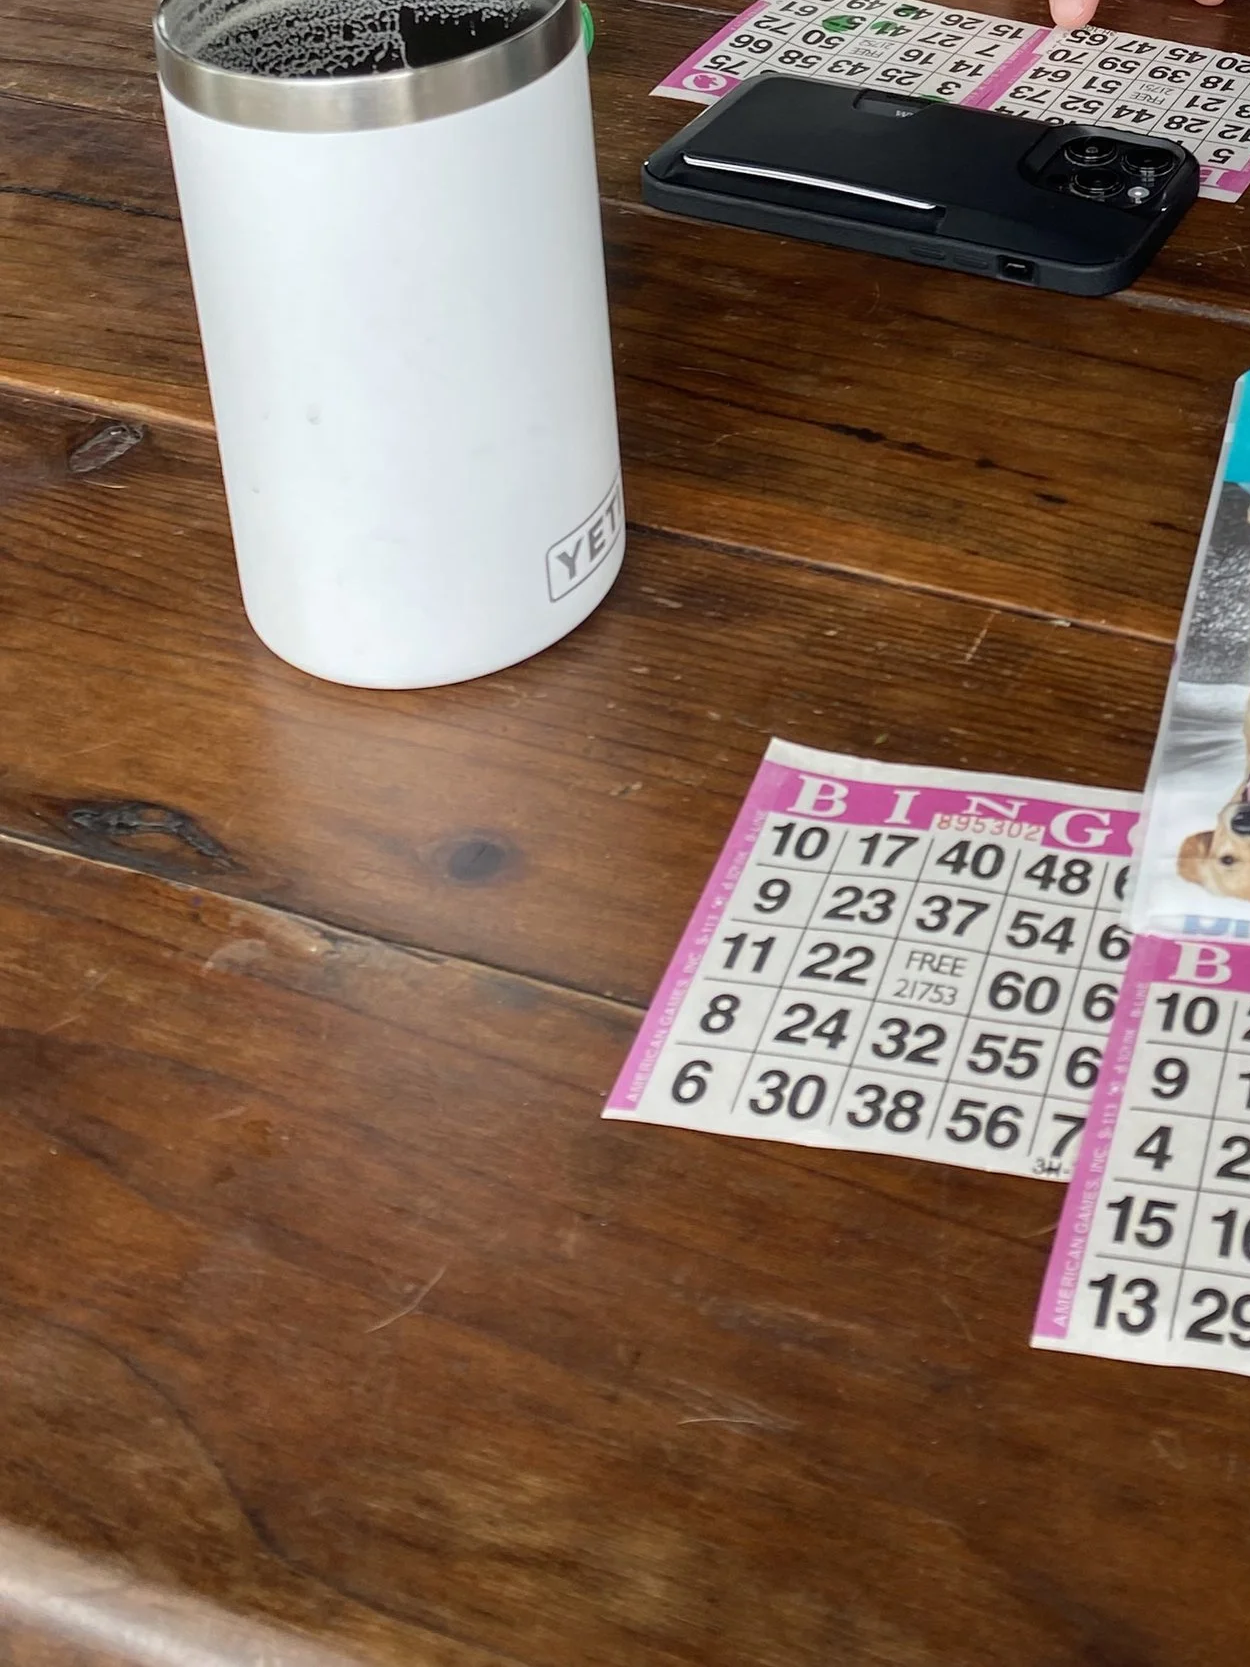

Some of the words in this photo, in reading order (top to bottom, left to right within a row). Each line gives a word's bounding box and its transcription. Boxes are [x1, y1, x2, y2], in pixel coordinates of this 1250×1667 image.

[893, 3, 934, 20] 42
[940, 14, 984, 30] 26
[988, 24, 1025, 39] 15
[1065, 29, 1109, 46] 65
[853, 48, 883, 59] FREE
[1113, 40, 1157, 54] 47
[1164, 47, 1208, 64] 45
[1131, 92, 1167, 105] FREE
[787, 773, 1142, 852] BING
[935, 812, 1042, 844] 895302
[773, 822, 829, 860] 10
[860, 833, 919, 867] 17
[937, 840, 1004, 879] 40
[1025, 854, 1093, 895] 48
[724, 933, 775, 972] 11
[799, 942, 874, 984] 22
[905, 951, 967, 978] FREE
[989, 970, 1060, 1014] 60
[893, 978, 959, 1006] 21753
[1157, 992, 1219, 1035] 10
[1135, 1126, 1172, 1170] 4
[1053, 1238, 1085, 1328] AMERICAN
